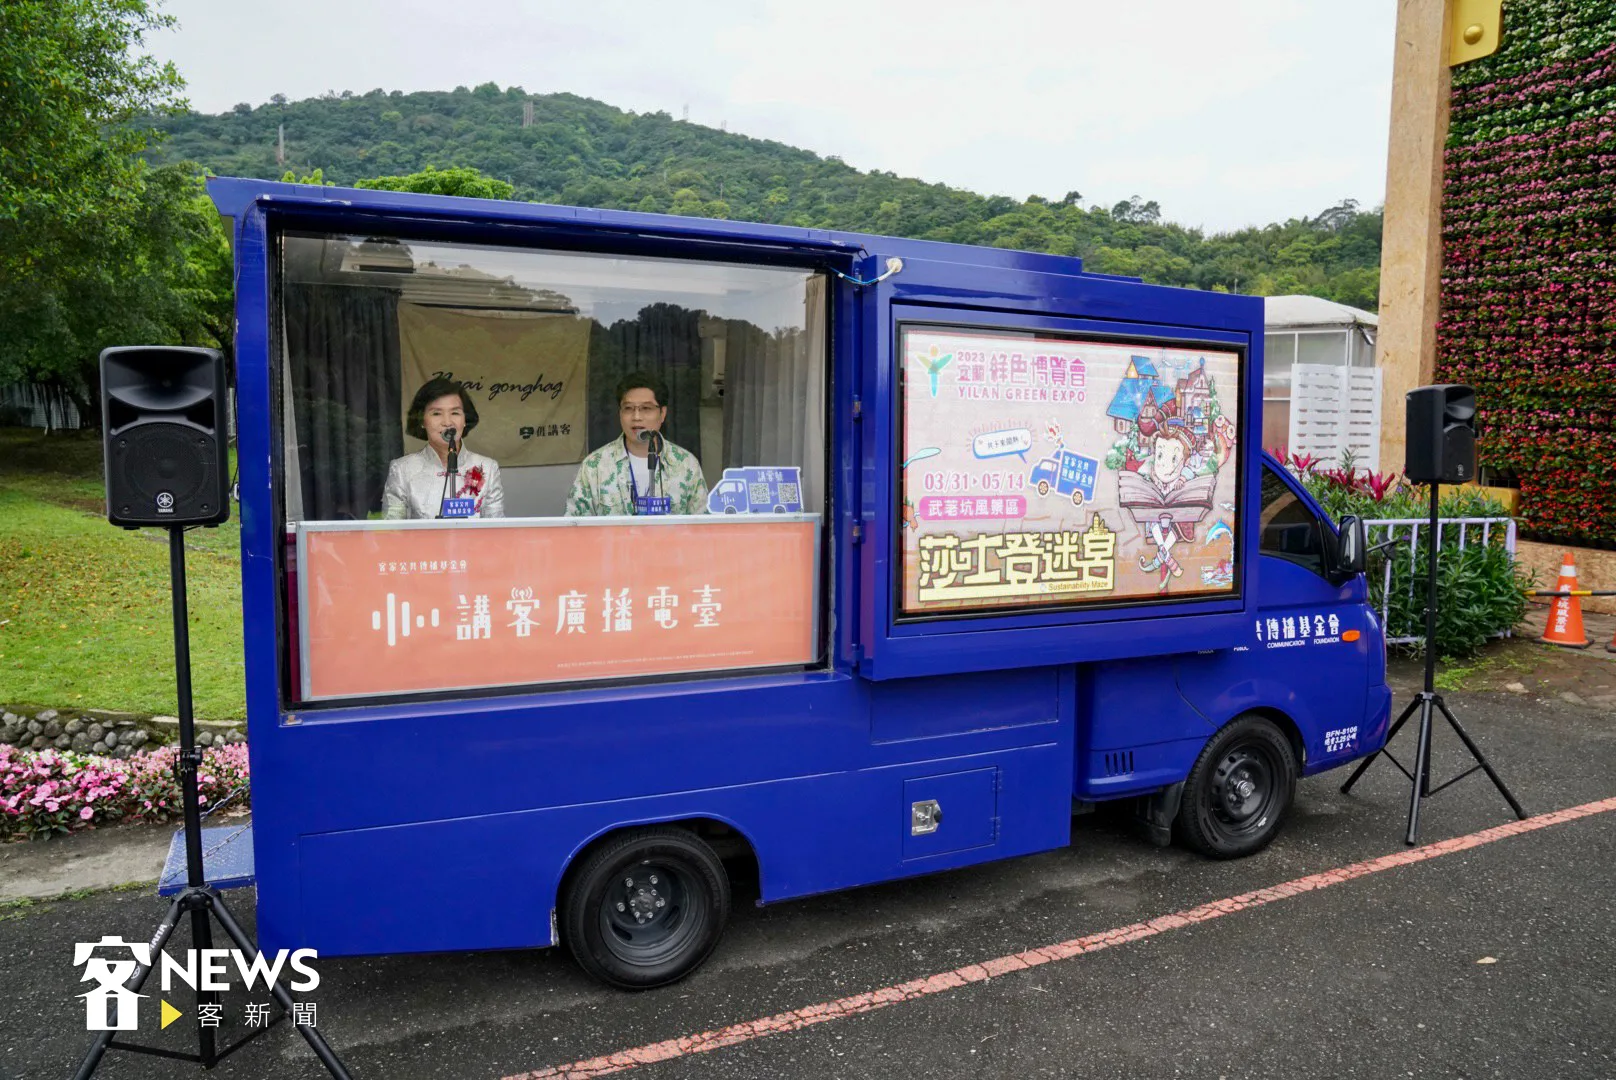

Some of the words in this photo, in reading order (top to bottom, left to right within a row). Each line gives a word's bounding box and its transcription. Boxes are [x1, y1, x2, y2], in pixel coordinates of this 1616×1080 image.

[957, 351, 986, 362] 2023
[989, 353, 1086, 387] 綠色博覽會
[958, 386, 1000, 400] YILAN
[1005, 387, 1048, 401] GREEN
[1052, 390, 1086, 402] EXPO
[925, 473, 968, 491] 03/31
[982, 472, 1023, 490] 05/14
[456, 584, 722, 641] 講客廣播電臺
[1267, 640, 1306, 649] COMMUNICATION
